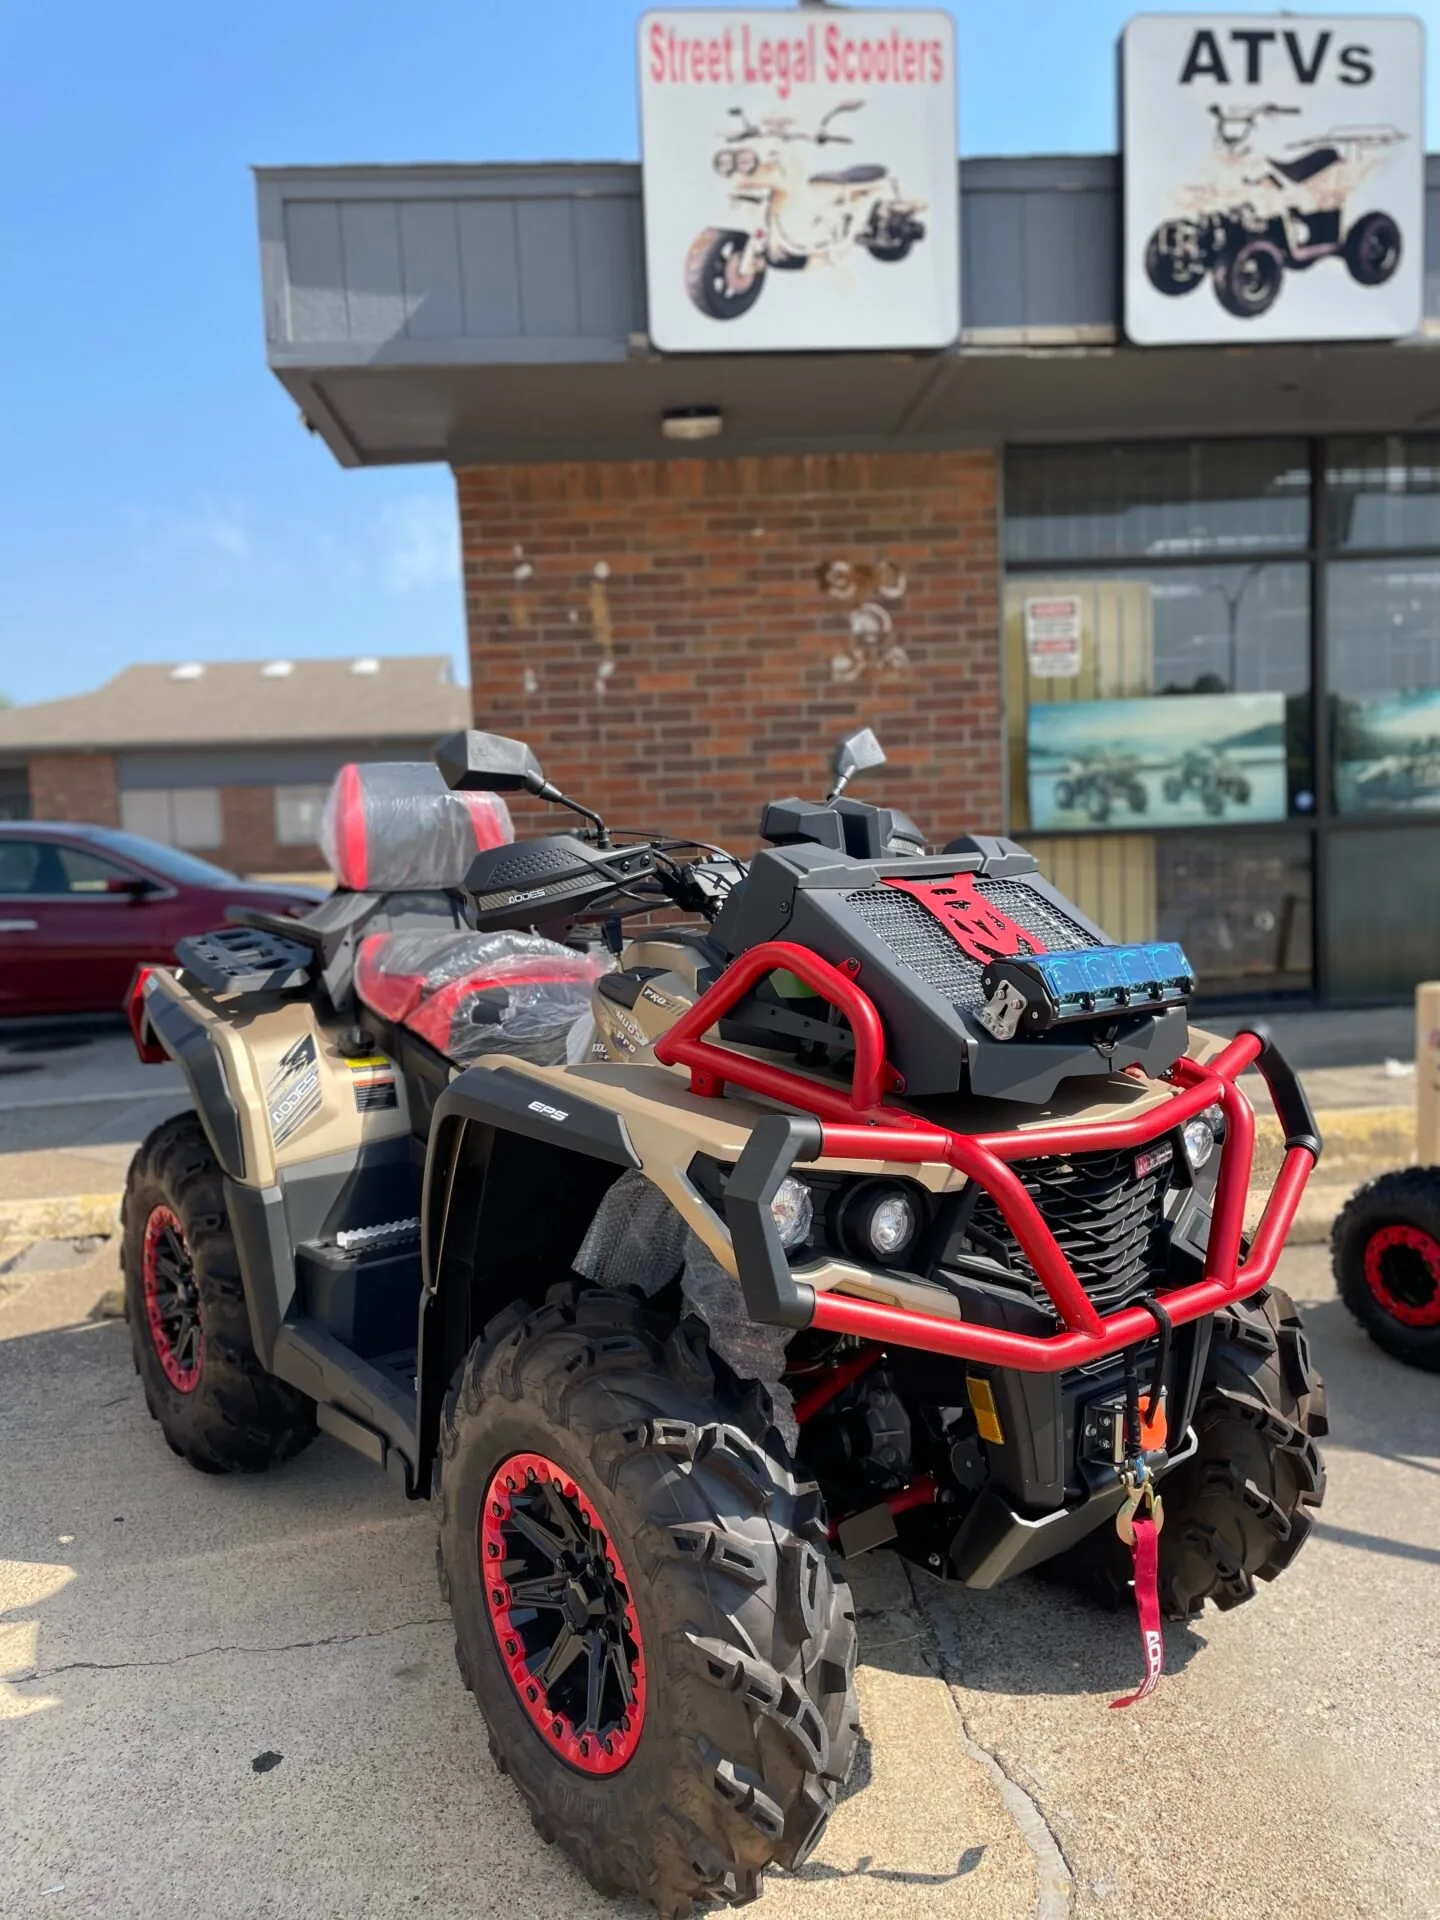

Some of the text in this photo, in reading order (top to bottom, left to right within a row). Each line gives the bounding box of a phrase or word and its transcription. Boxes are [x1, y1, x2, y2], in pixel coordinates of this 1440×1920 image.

[650, 21, 944, 100] Street Legal Scooters
[1178, 28, 1375, 86] ATVs
[508, 888, 546, 904] AODES
[644, 987, 667, 1005] PRO
[272, 1072, 318, 1124] AODES
[527, 1101, 569, 1121] EPS
